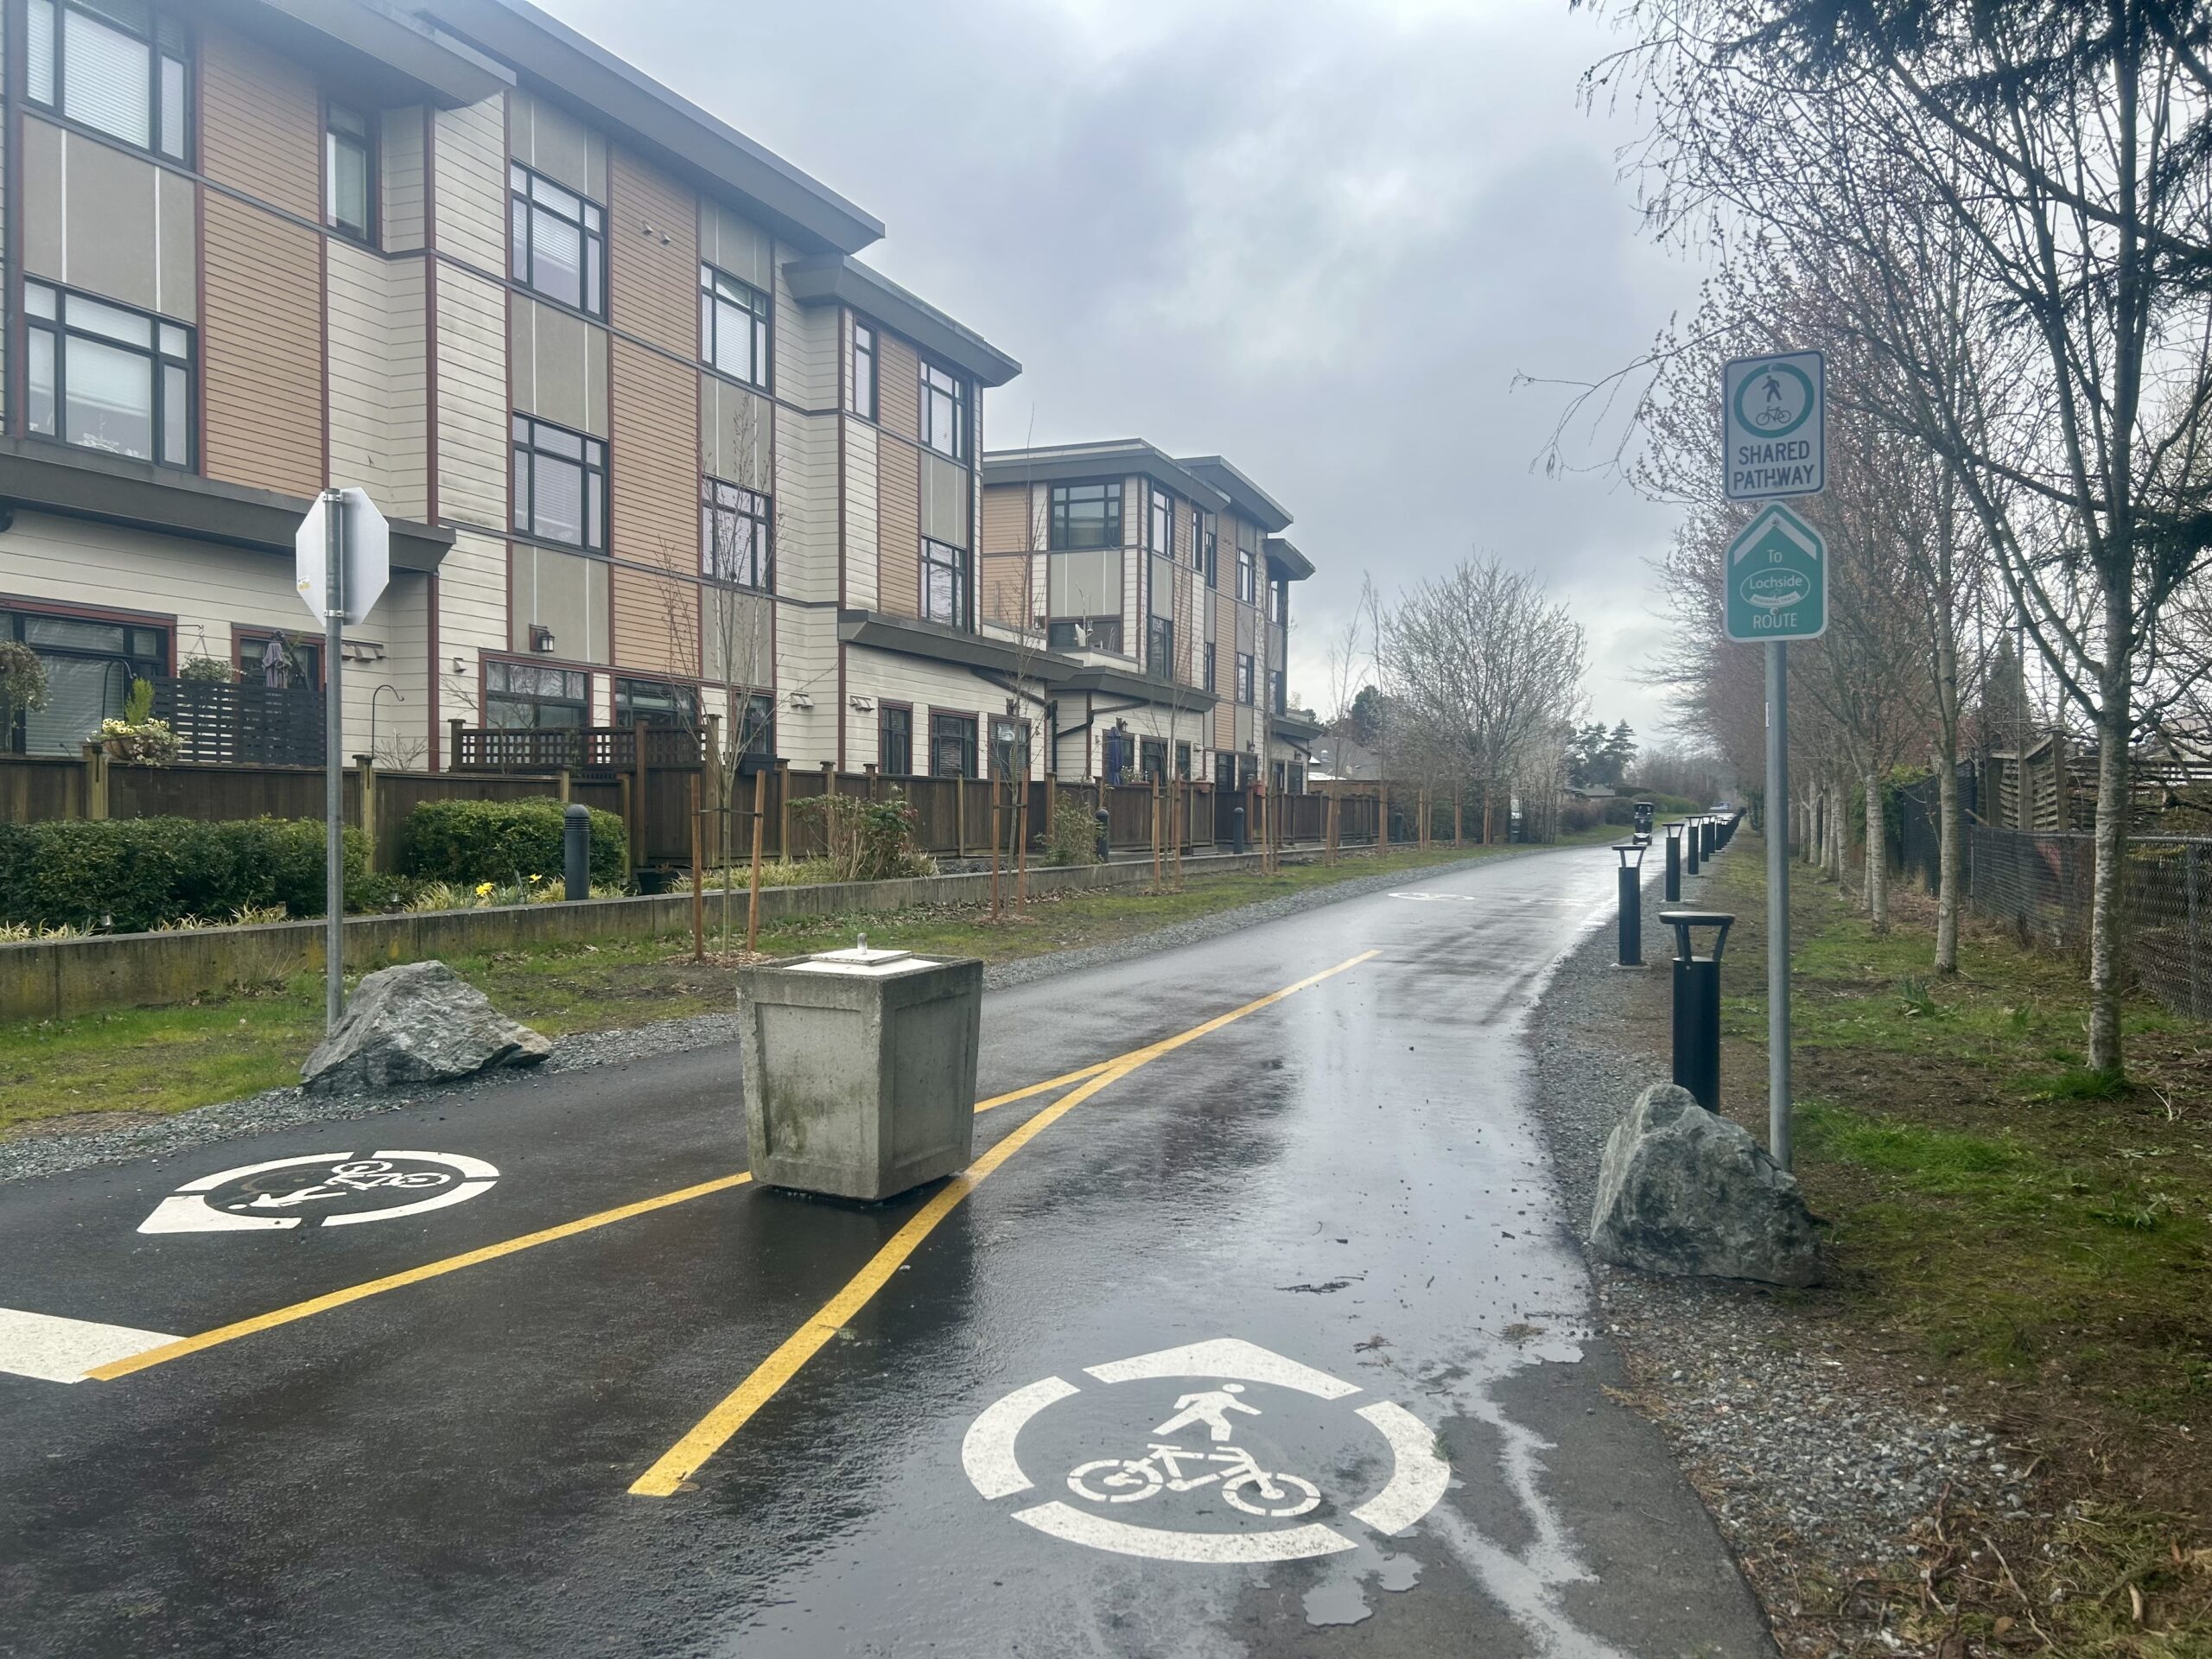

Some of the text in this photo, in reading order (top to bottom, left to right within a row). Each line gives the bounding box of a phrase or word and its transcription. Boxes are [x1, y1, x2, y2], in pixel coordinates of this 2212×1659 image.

[1738, 440, 1810, 465] SHARED
[1733, 464, 1815, 490] PATHWAY
[1767, 549, 1782, 563] To
[1750, 575, 1802, 589] Lochside
[1753, 613, 1797, 629] ROUTE
